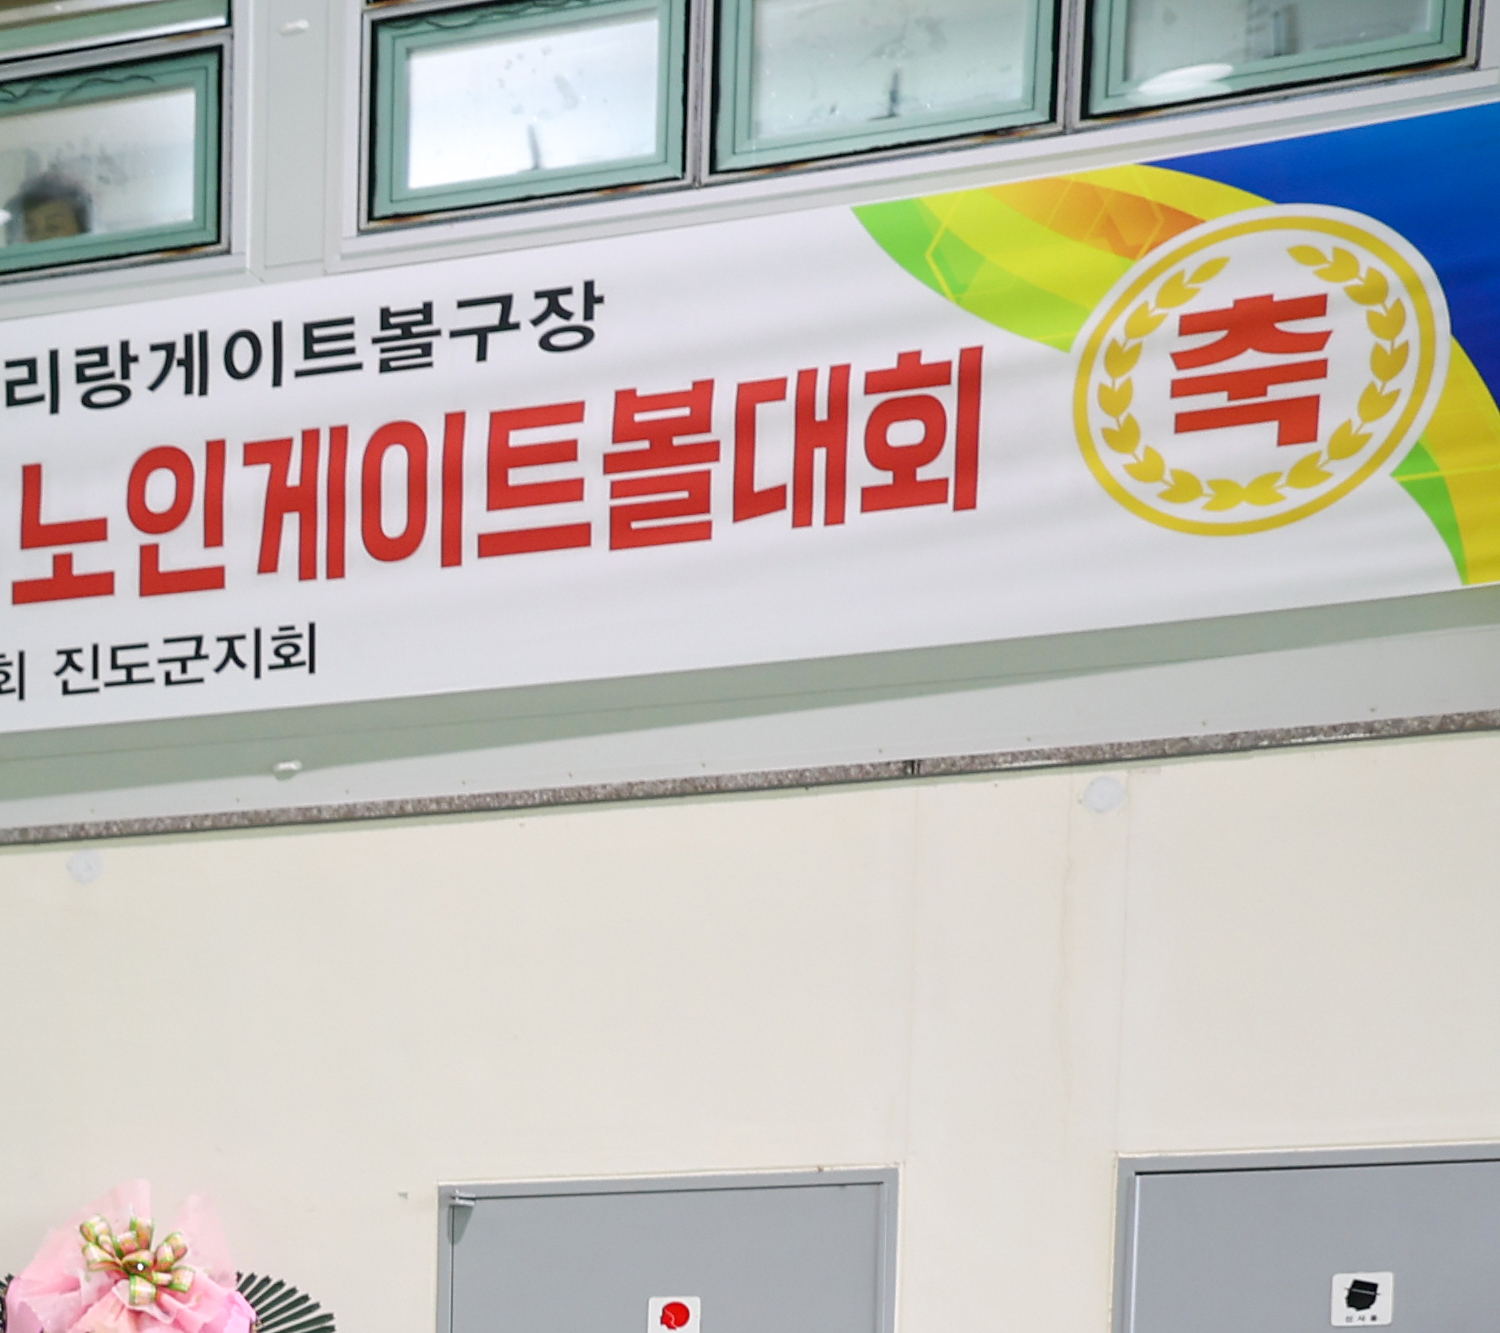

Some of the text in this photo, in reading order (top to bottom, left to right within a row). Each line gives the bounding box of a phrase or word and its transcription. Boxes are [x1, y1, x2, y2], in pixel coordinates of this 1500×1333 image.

[1168, 291, 1334, 448] 축
[10, 344, 986, 607] 노인게이트볼대회
[53, 622, 318, 697] 진도군지회
